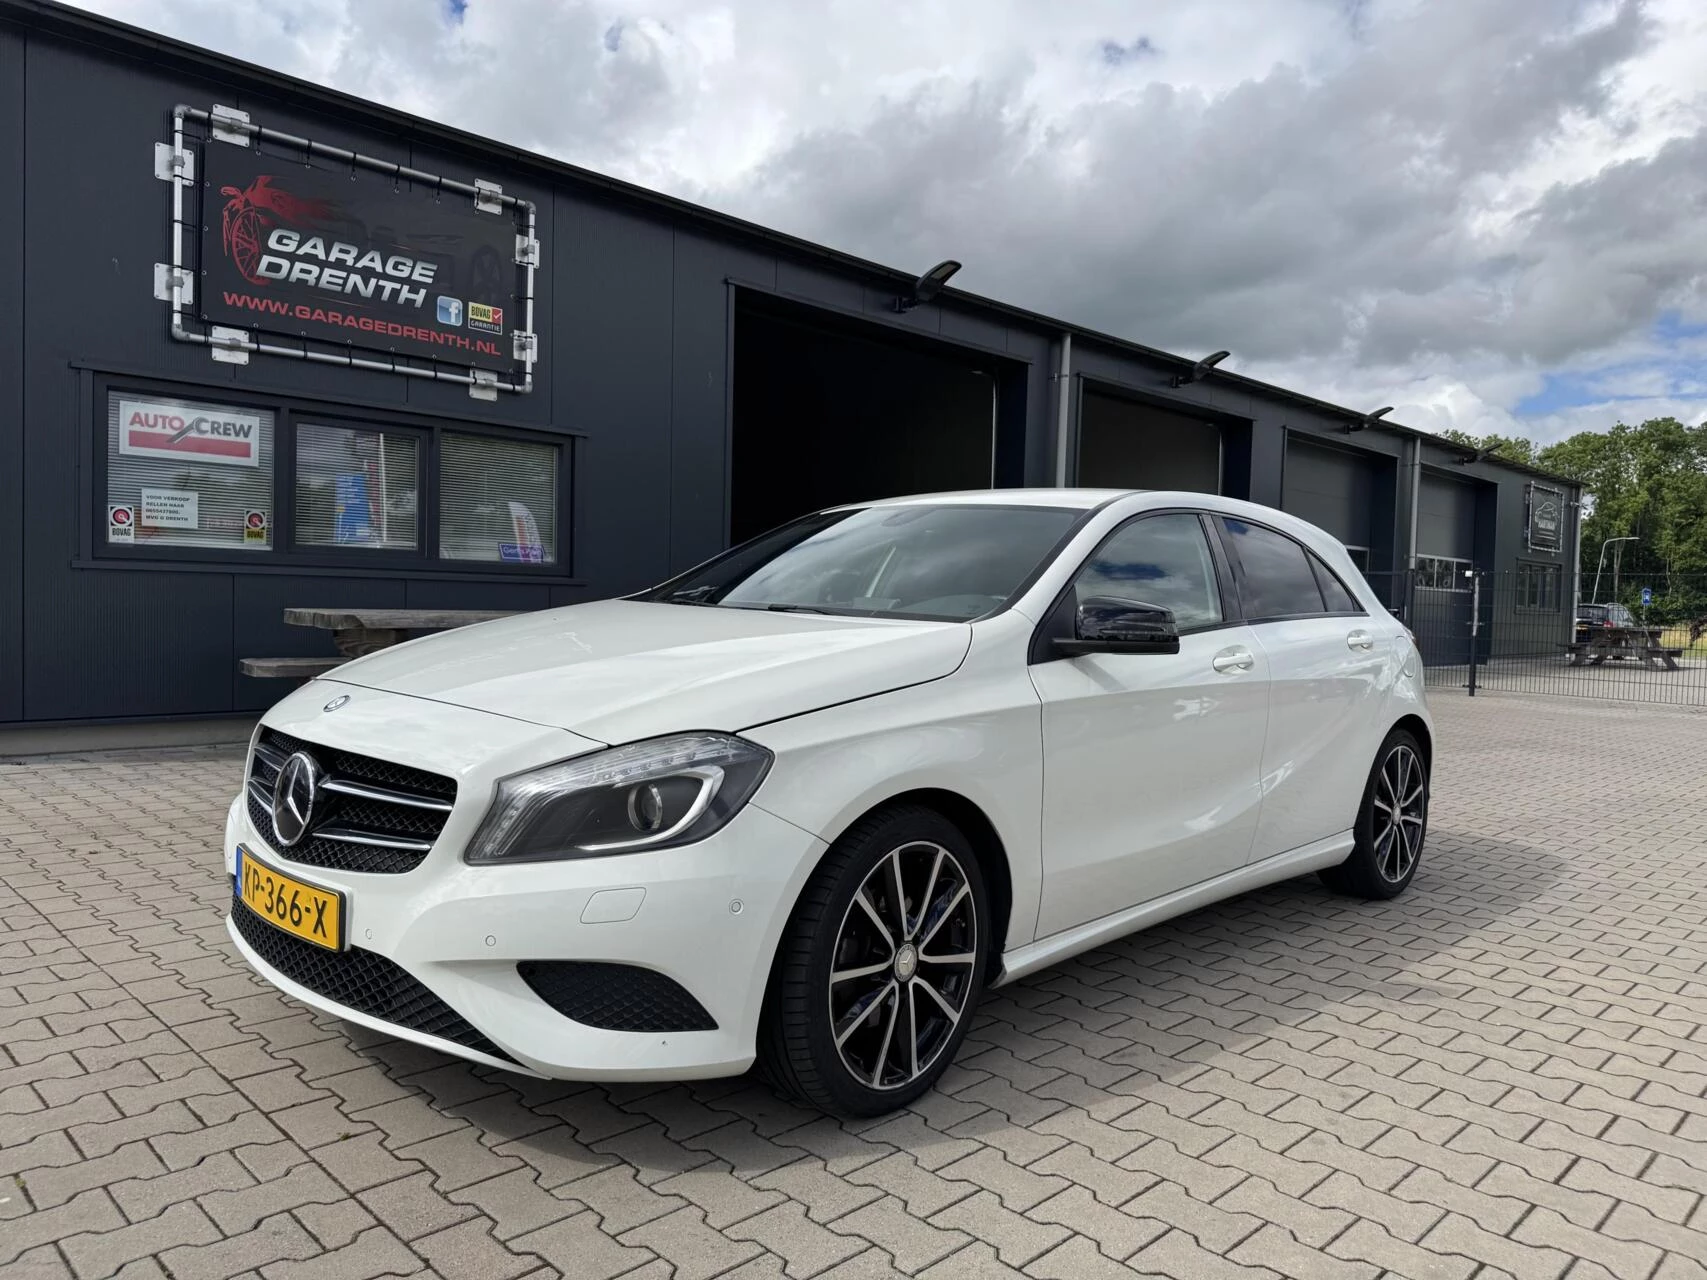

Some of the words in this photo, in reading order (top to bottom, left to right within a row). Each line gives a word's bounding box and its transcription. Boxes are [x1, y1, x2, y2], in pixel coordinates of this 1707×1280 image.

[267, 228, 438, 284] GARAGE
[256, 255, 427, 308] DRENTH
[223, 292, 502, 356] WWW.GARAGEDRENTH.NL
[470, 320, 501, 331] GARANTIE
[471, 305, 491, 320] BOVAG
[129, 411, 185, 431] AUTO
[193, 416, 252, 438] CREW
[112, 528, 131, 537] BOVAG
[247, 530, 264, 538] BOVAG
[244, 862, 328, 938] KP-366-X
